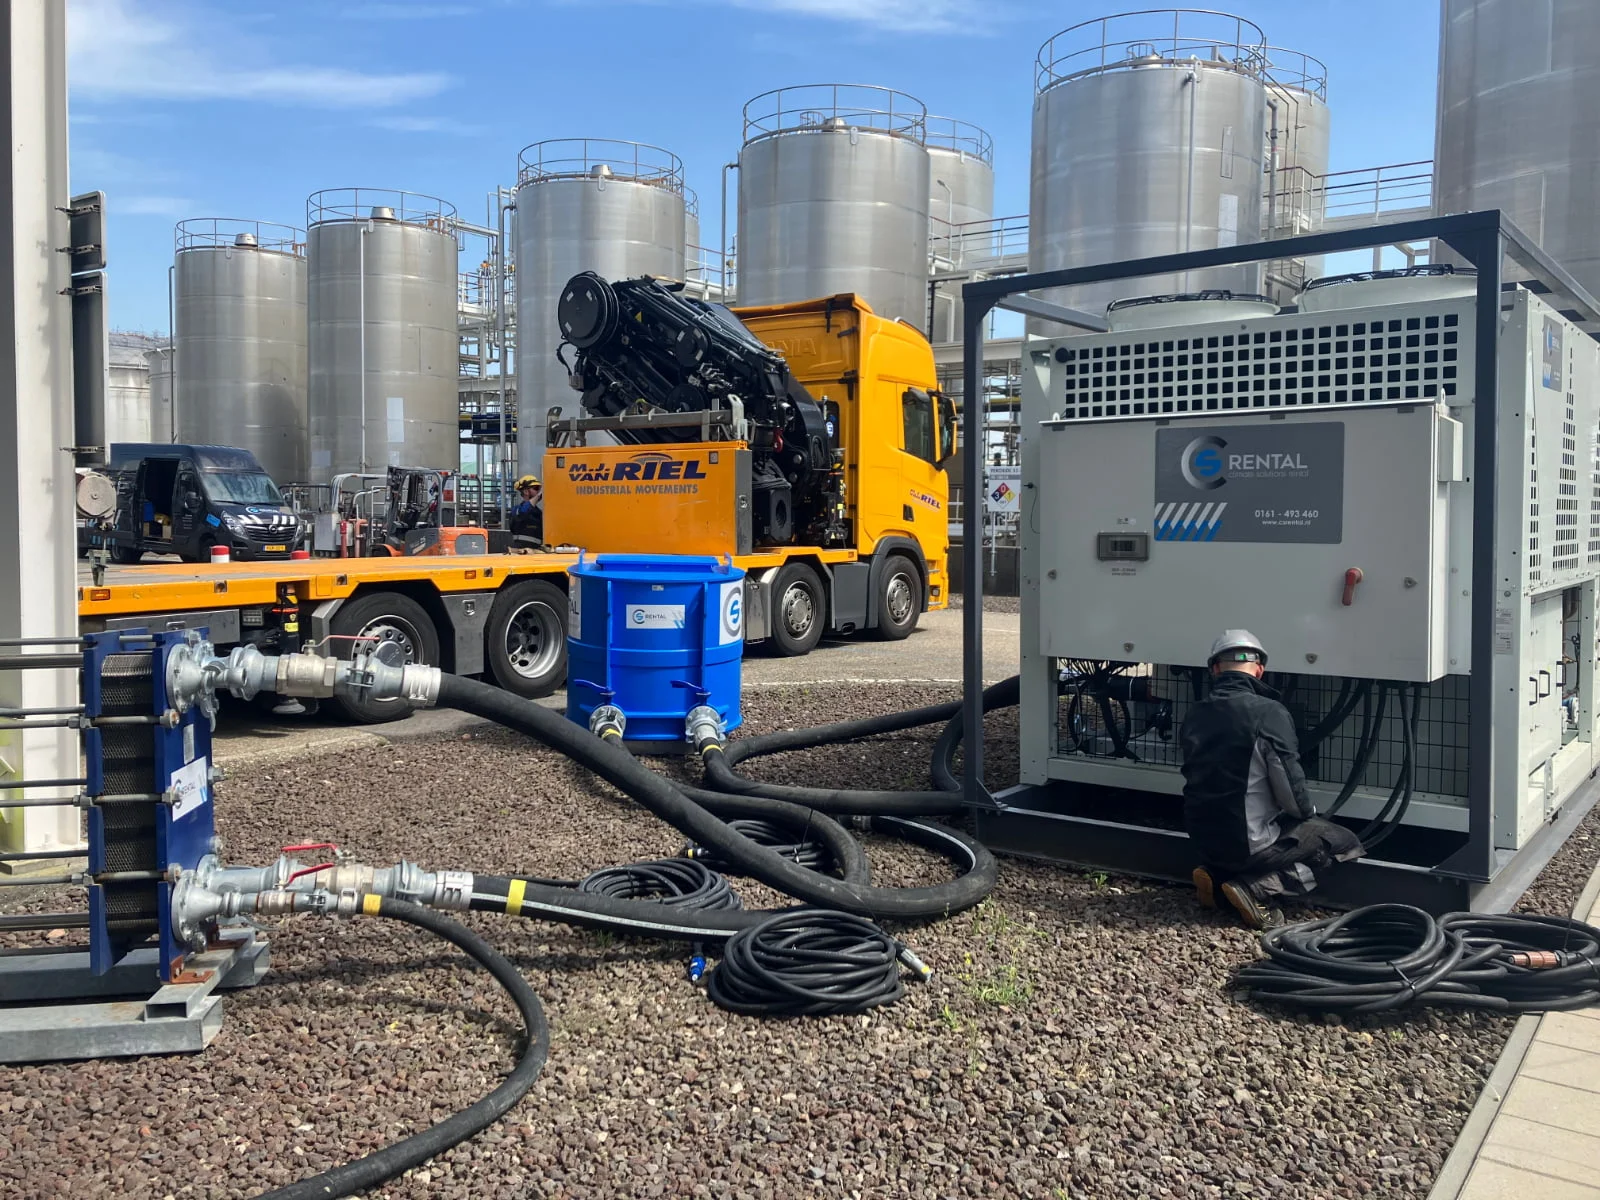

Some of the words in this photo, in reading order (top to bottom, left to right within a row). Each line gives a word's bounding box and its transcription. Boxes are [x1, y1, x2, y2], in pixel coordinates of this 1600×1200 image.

[568, 463, 610, 472] M.J.
[1228, 453, 1308, 470] RENTAL
[568, 473, 610, 482] VAN
[612, 460, 707, 481] RIEL
[576, 485, 632, 495] INDUSTRIAL
[635, 484, 698, 495] MOVEMENTS
[921, 494, 941, 509] RIEL
[1254, 509, 1275, 518] 0161
[1284, 509, 1300, 518] 493
[1302, 509, 1319, 518] 460
